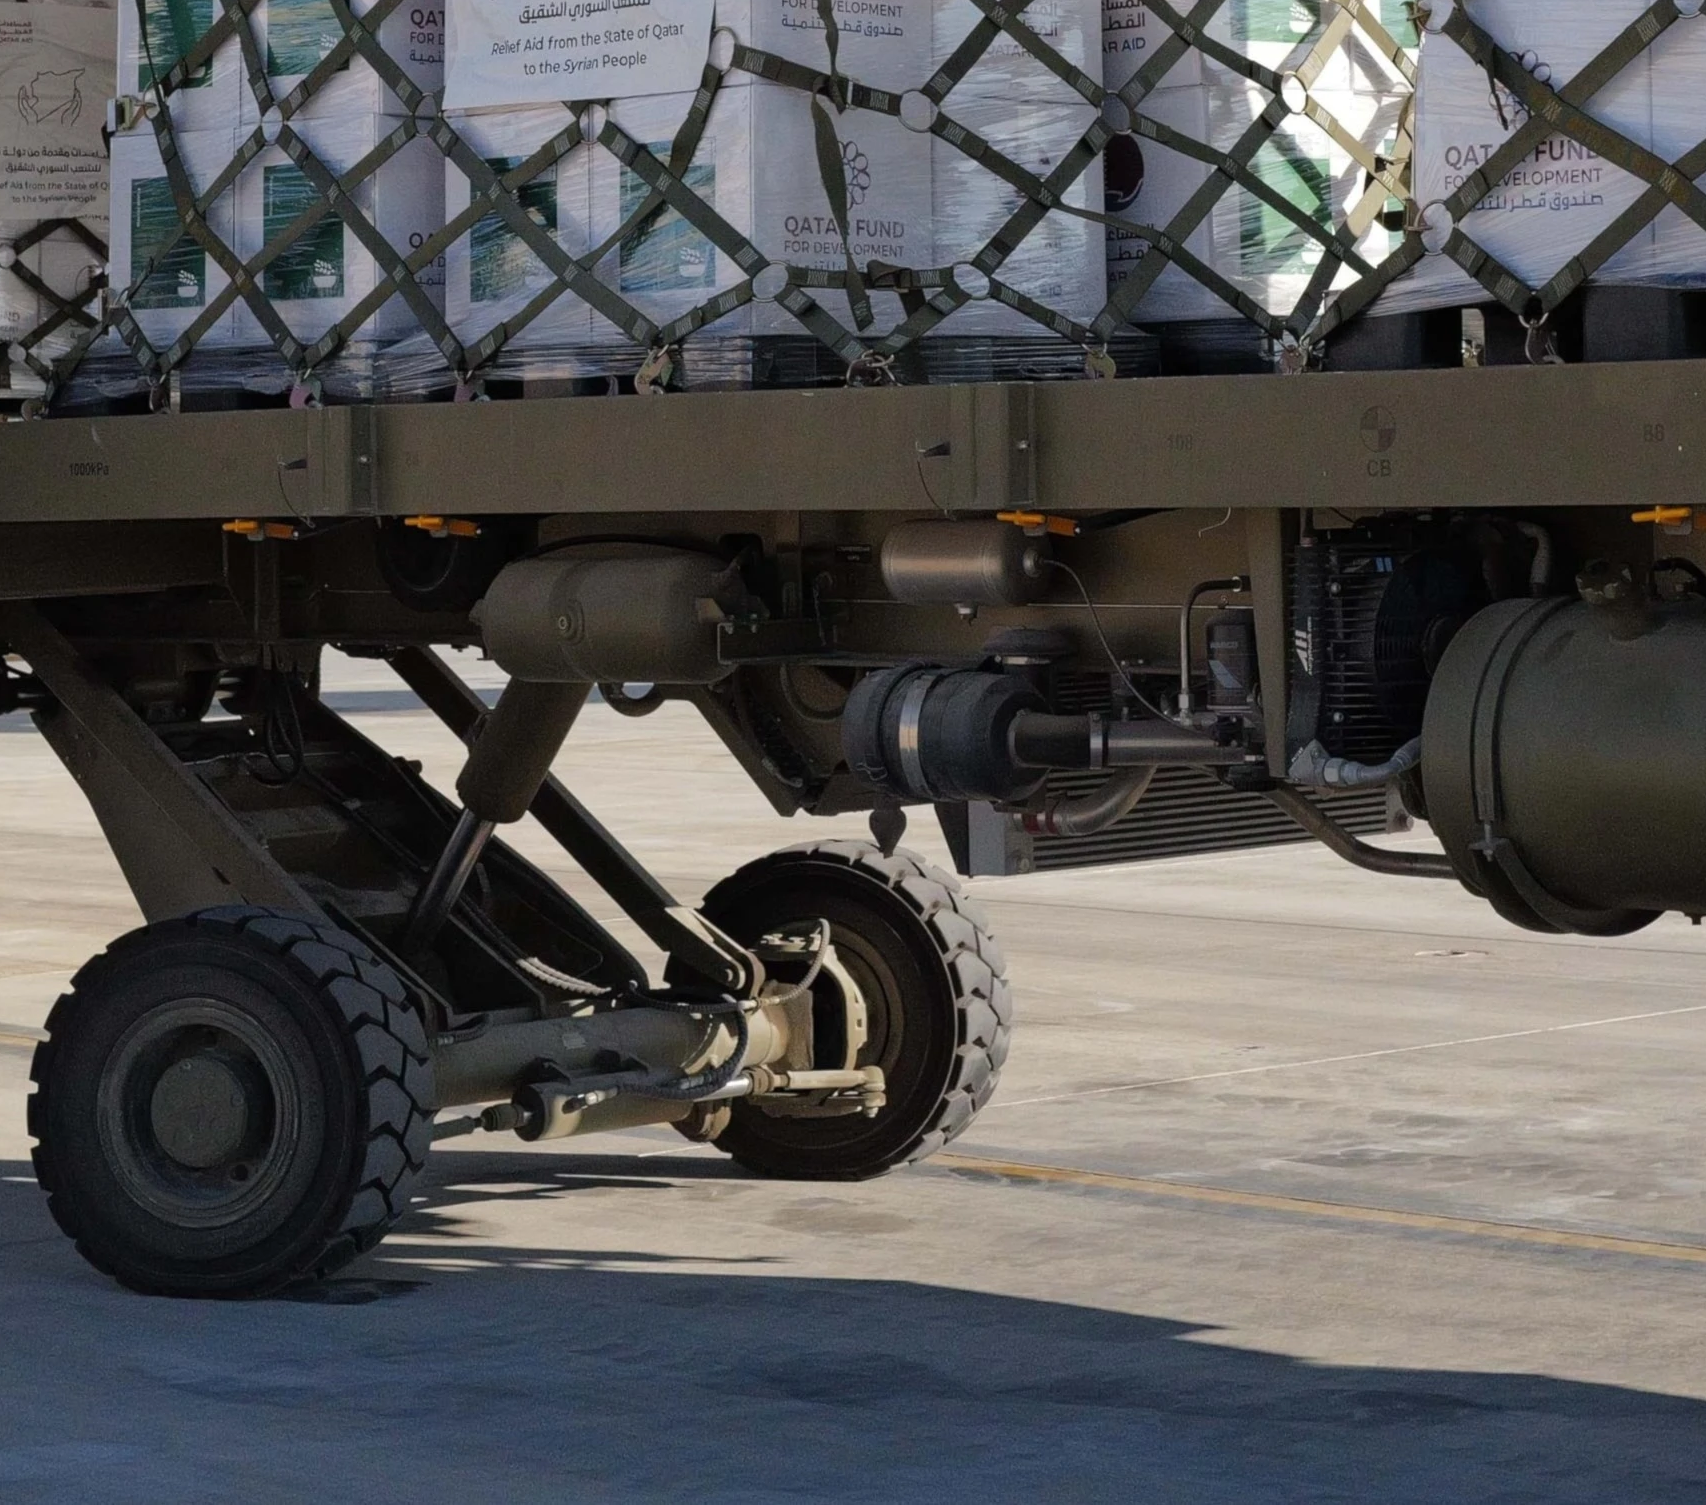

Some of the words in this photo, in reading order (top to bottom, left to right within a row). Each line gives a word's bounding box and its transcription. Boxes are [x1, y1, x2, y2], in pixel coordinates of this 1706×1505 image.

[519, 1, 567, 24] الشقيق
[410, 31, 434, 45] FOR
[864, 22, 903, 37] صندوق
[491, 39, 522, 56] Relief
[524, 36, 543, 52] Aid
[548, 34, 577, 50] from
[581, 31, 600, 47] the
[604, 28, 634, 45] State
[637, 25, 649, 39] of
[652, 23, 684, 40] Qatar
[1122, 37, 1146, 51] AID
[524, 63, 536, 75] to
[539, 60, 560, 74] the
[563, 56, 598, 74] Syrian
[602, 51, 647, 70] People
[25, 181, 45, 190] from
[48, 181, 62, 190] the
[65, 181, 87, 190] State
[89, 181, 99, 190] of
[12, 195, 20, 203] to
[1509, 191, 1546, 212] قطر
[1549, 190, 1604, 211] صندوق
[856, 219, 904, 238] FUND
[784, 240, 809, 253] FOR
[1366, 459, 1392, 478] CB
